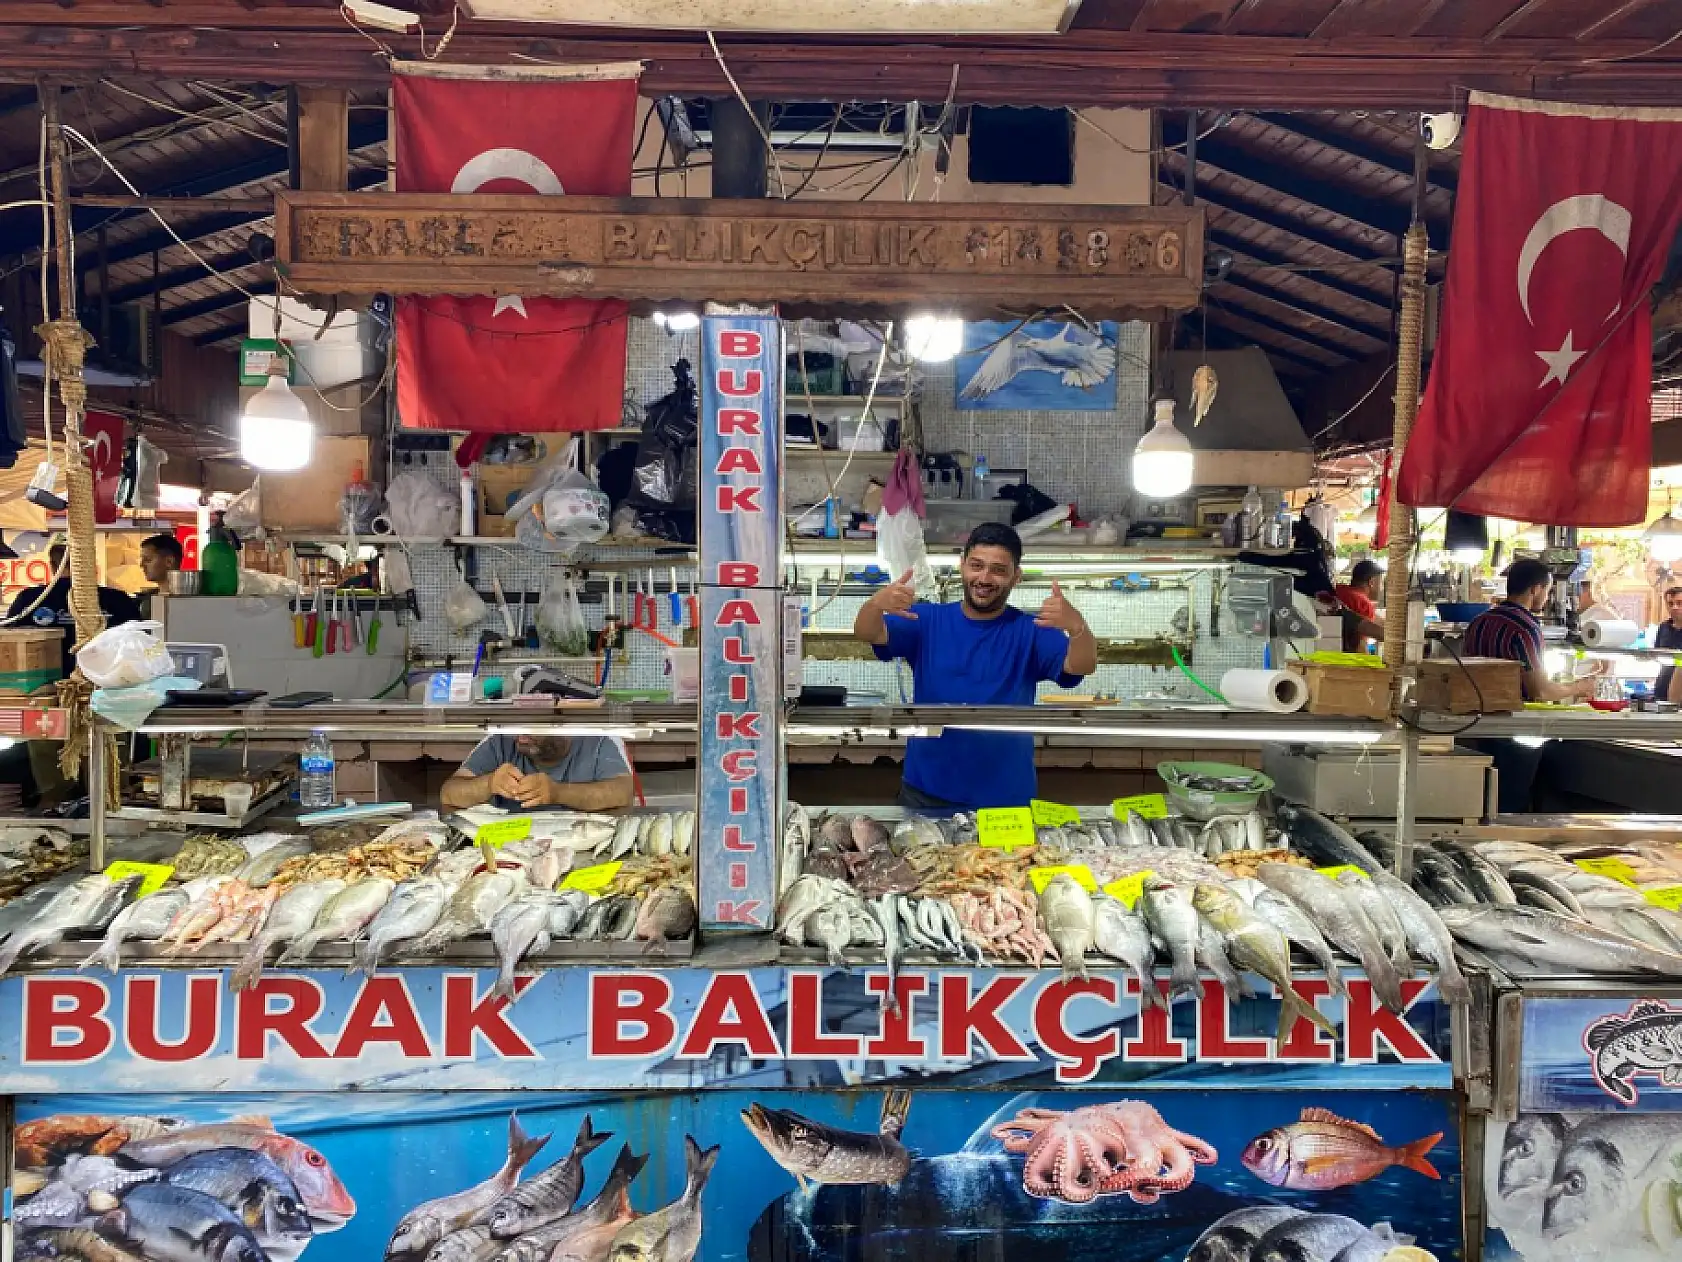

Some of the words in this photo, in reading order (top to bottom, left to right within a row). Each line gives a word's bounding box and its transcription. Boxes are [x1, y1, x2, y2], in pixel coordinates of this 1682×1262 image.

[603, 219, 940, 272] BALIKÇILIK
[715, 329, 764, 513] BURAK
[714, 561, 761, 925] BALIKÇILIK
[22, 973, 545, 1066] BURAK
[588, 971, 1443, 1083] BALIKÇILIK
